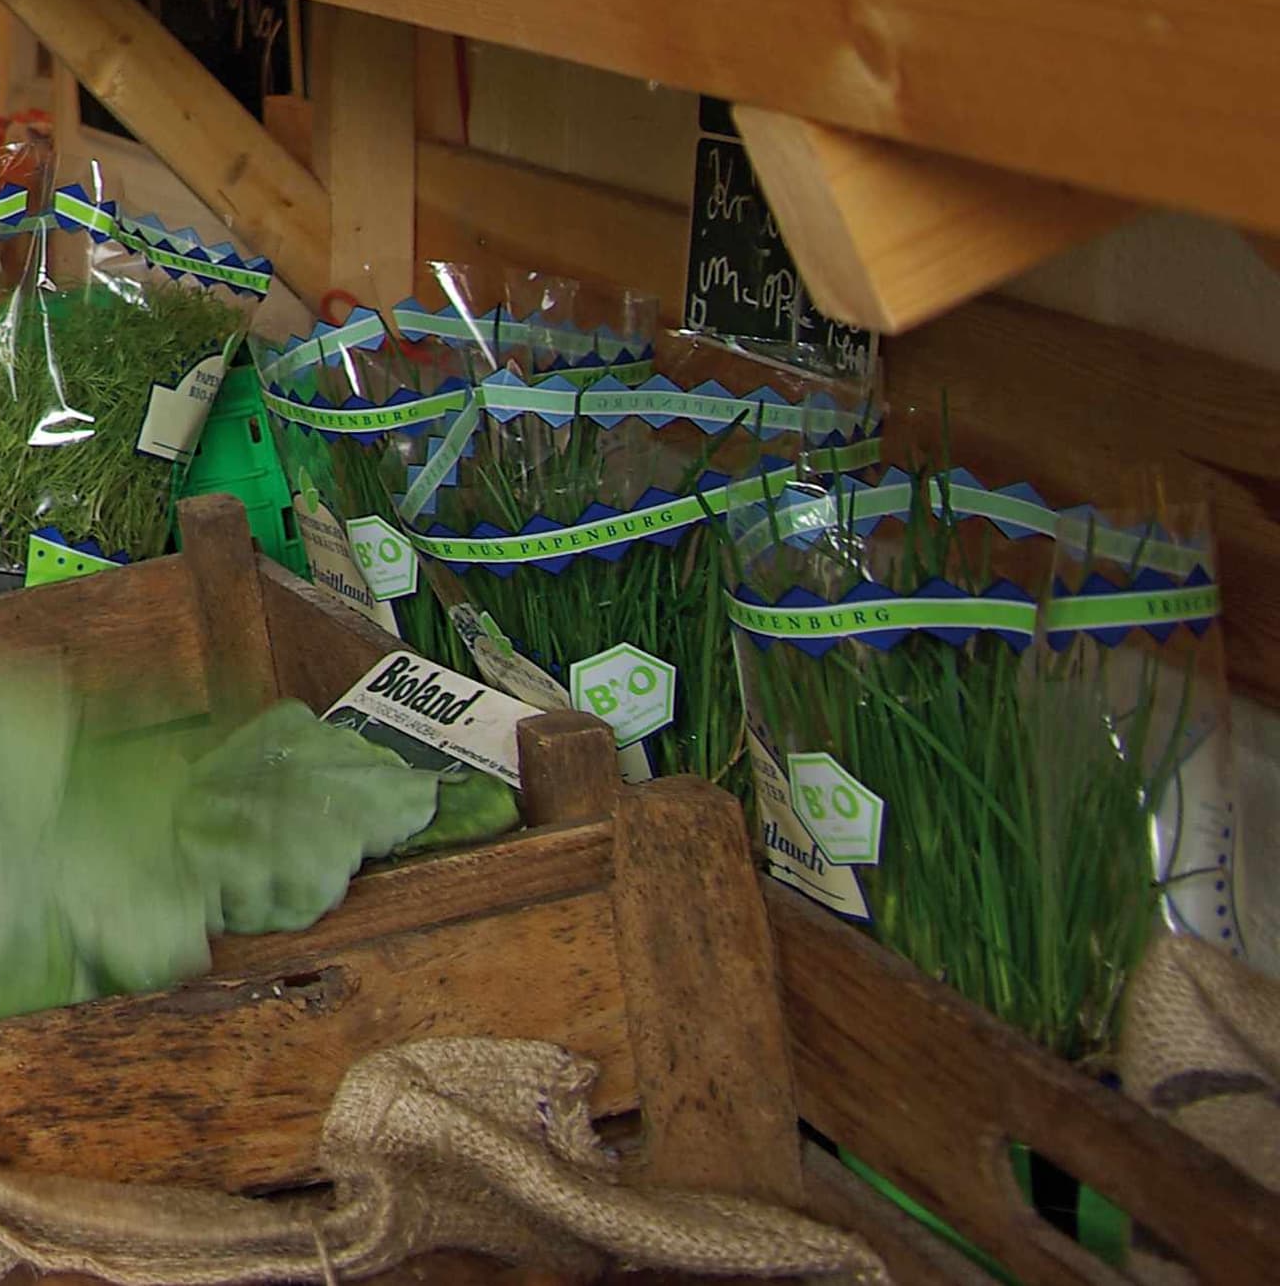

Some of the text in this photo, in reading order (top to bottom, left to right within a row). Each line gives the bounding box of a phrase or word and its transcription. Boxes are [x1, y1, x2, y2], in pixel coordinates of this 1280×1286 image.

[467, 545, 505, 556] AUS
[521, 510, 673, 555] PAPENBURG
[365, 655, 486, 726] Bioland
